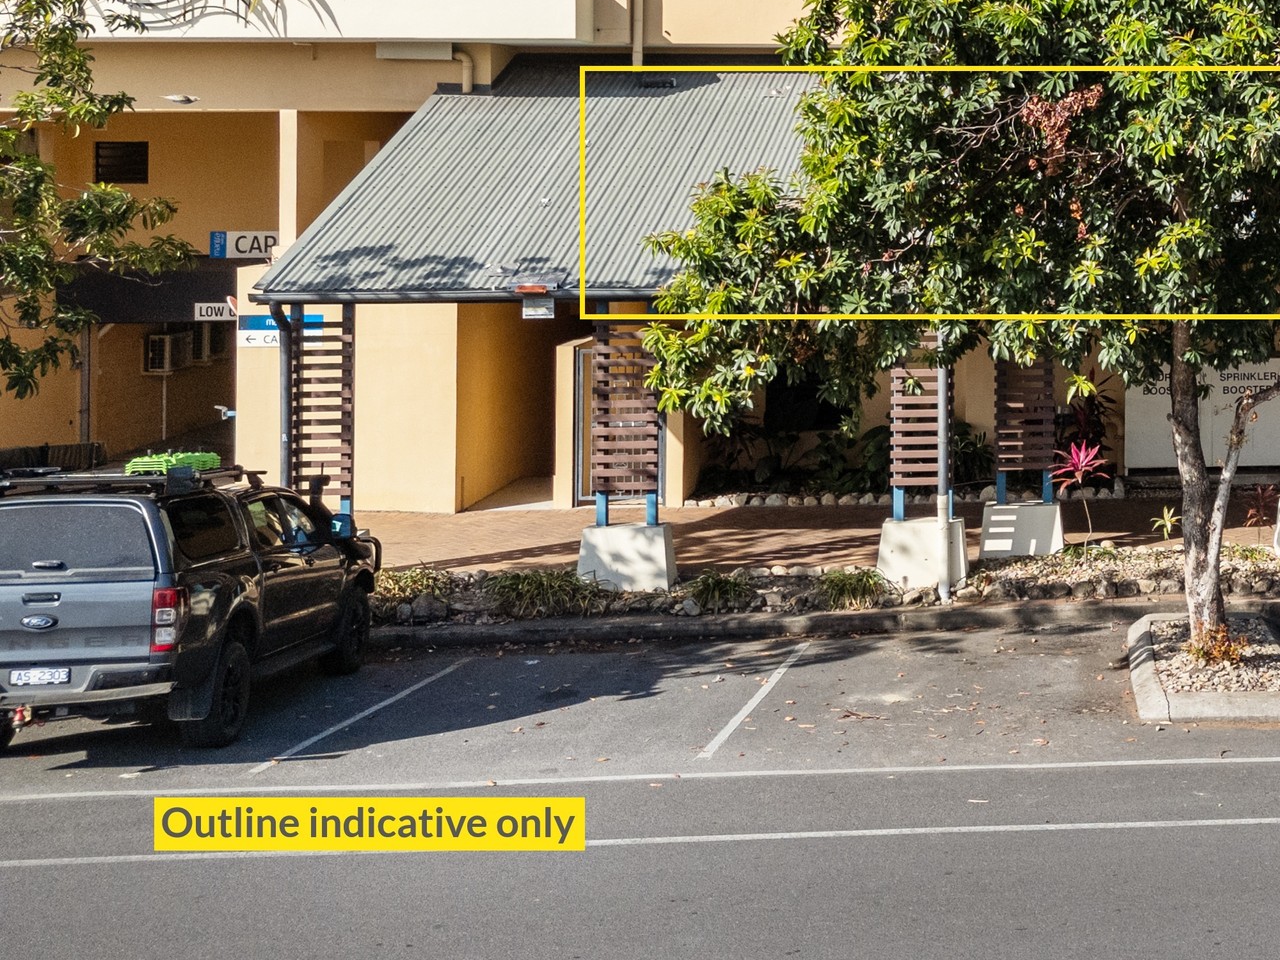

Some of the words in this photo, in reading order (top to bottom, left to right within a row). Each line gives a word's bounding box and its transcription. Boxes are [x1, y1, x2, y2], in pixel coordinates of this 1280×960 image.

[199, 306, 225, 317] LOW
[263, 335, 278, 344] CA
[1219, 372, 1277, 382] SPRINKLER
[1143, 386, 1171, 395] BOOS
